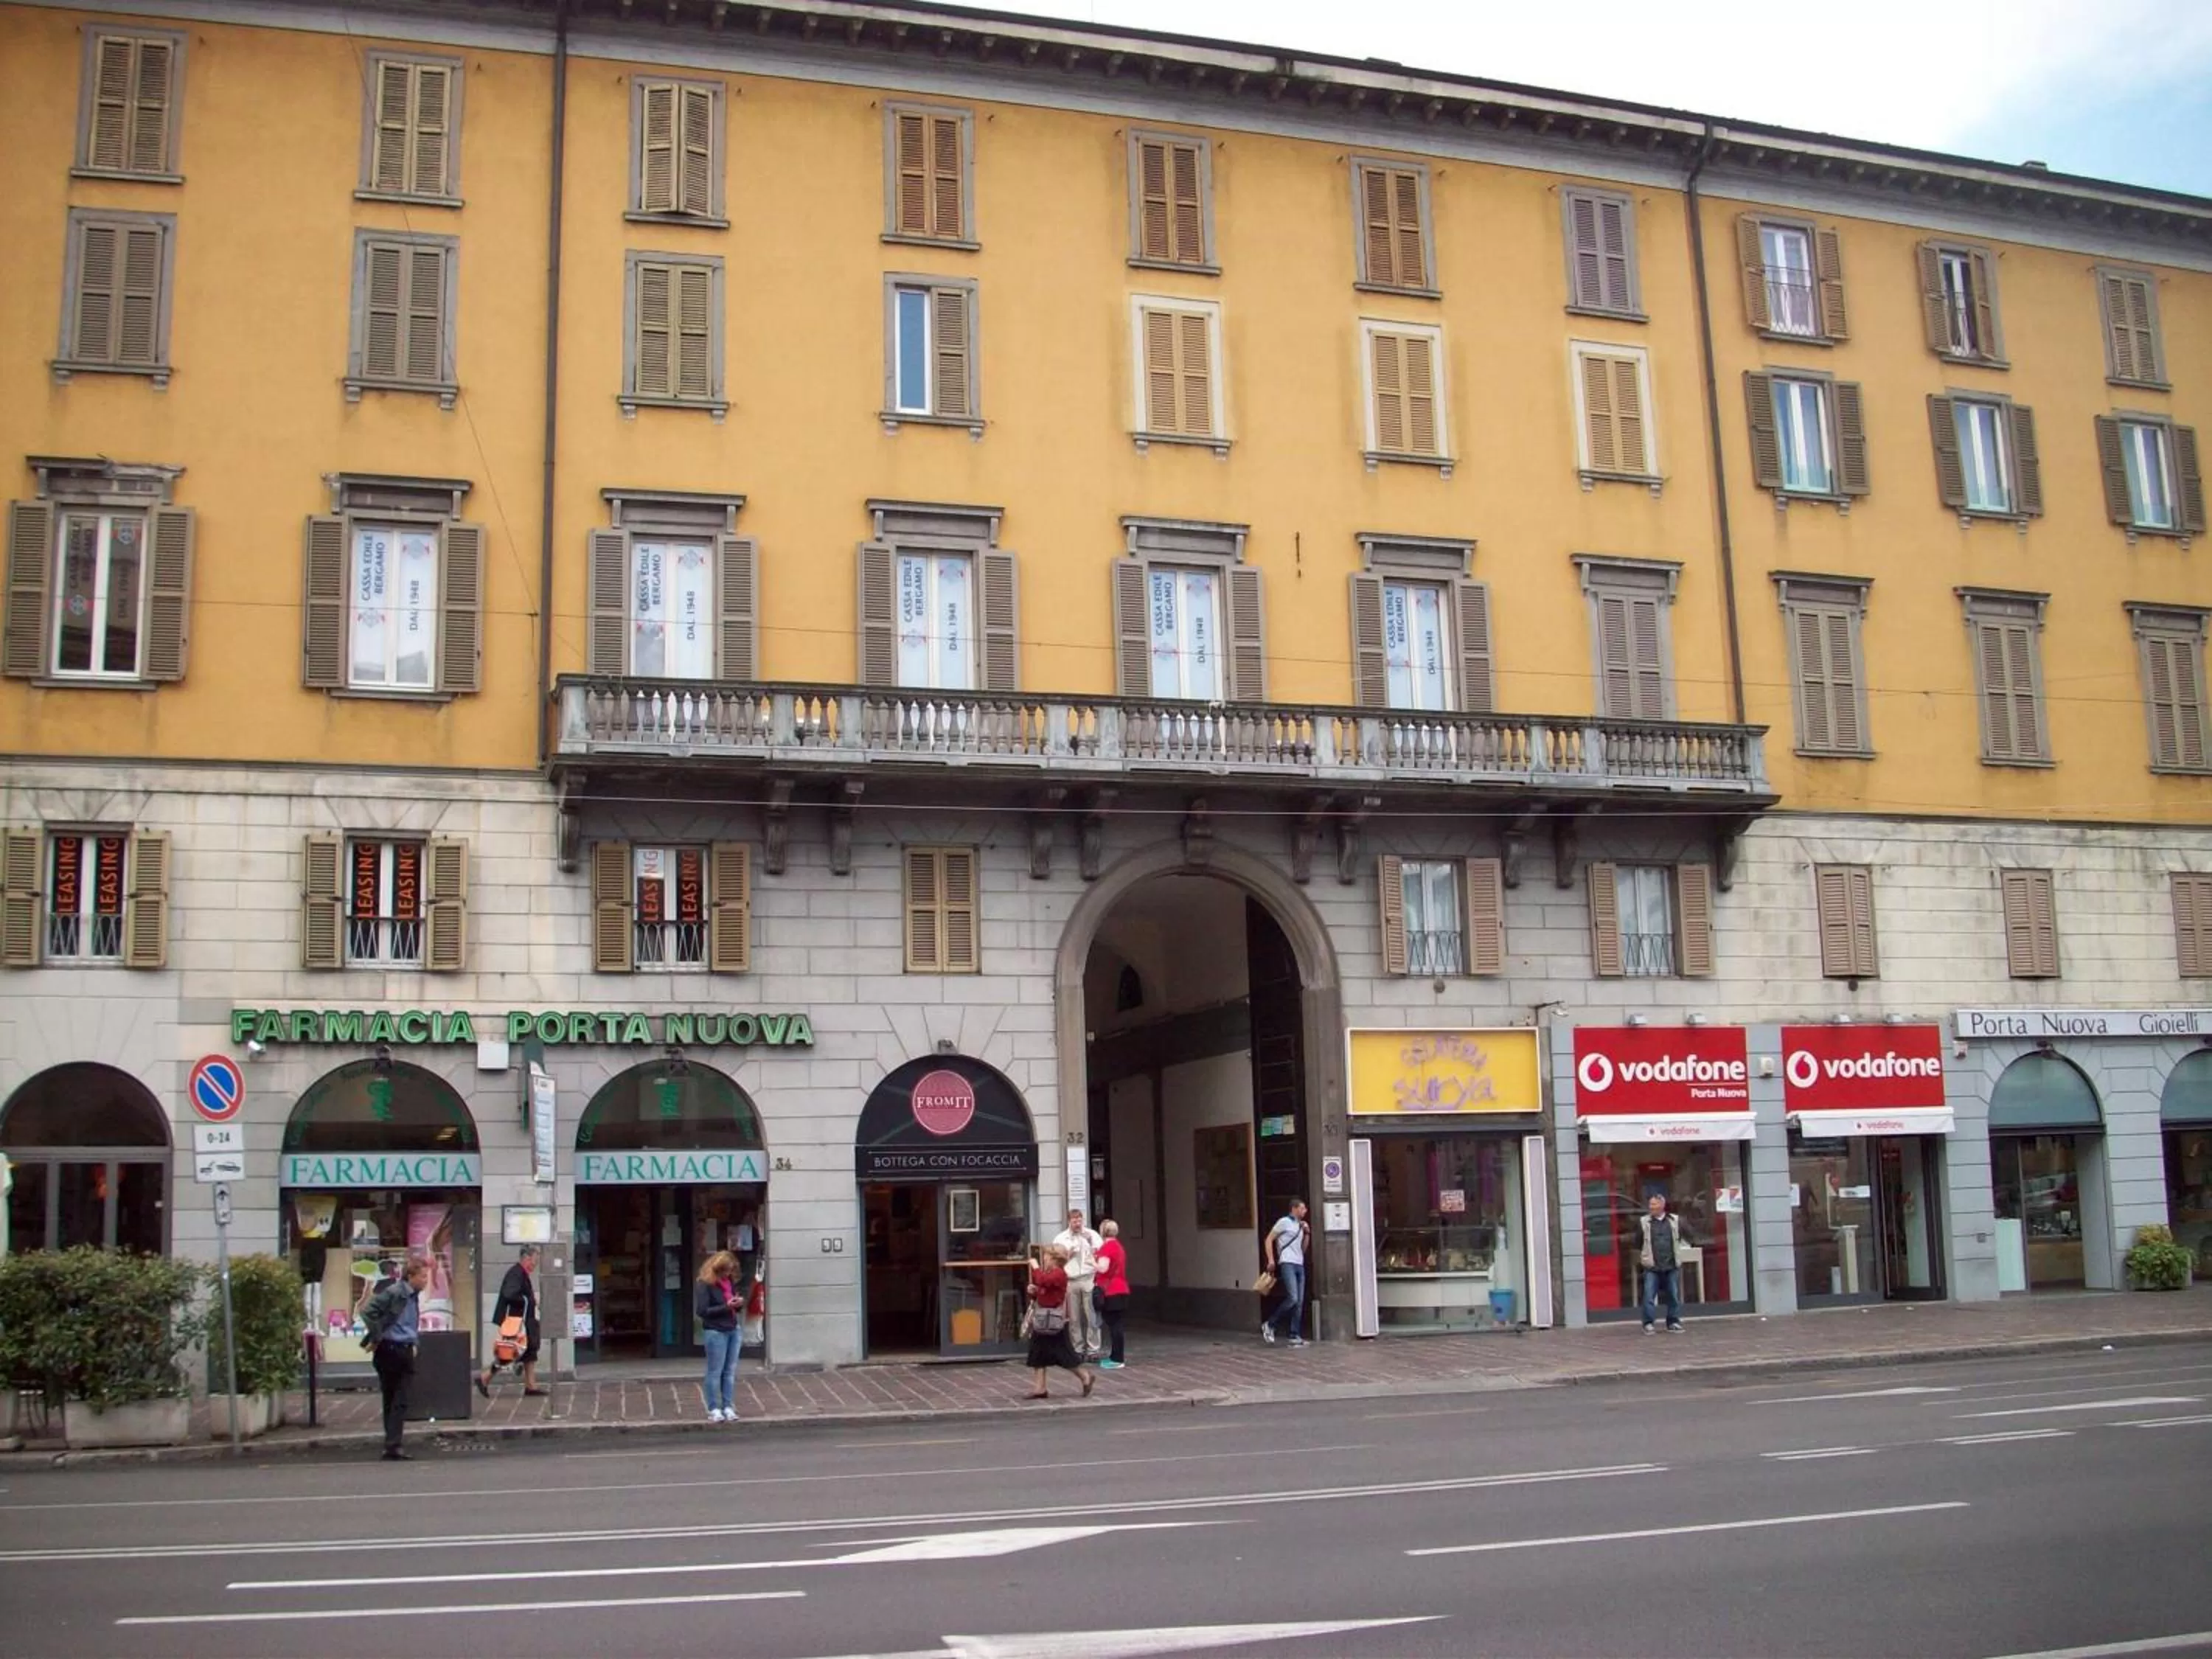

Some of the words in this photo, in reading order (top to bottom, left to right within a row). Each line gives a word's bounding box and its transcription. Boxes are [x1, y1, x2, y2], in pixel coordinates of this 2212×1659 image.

[364, 535, 373, 564] EDILE
[641, 546, 650, 576] EDILE
[374, 542, 385, 594] BERGAMO
[652, 554, 661, 605] BERGAMO
[903, 557, 912, 588] EDILE
[361, 567, 372, 601] CASSA
[409, 580, 420, 605] 1948
[639, 579, 650, 611] CASSA
[914, 567, 923, 616] BERGAMO
[1153, 574, 1163, 602] EDILE
[686, 591, 695, 614] 1948
[904, 591, 913, 622] CASSA
[948, 603, 957, 626] 1948
[1164, 582, 1174, 630] BERGAMO
[409, 608, 419, 631] DAL
[686, 621, 695, 640] DAL
[1154, 606, 1164, 636] CASSA
[1388, 619, 1396, 648] CASSA
[1395, 597, 1405, 642] BERGAMO
[949, 631, 958, 651] DAL
[1197, 644, 1206, 664] DAL
[58, 838, 77, 912] LEASING
[100, 838, 119, 913] LEASING
[357, 844, 375, 919] LEASING
[398, 844, 414, 919] LEASING
[681, 850, 697, 922] LEASING
[232, 1009, 477, 1043] FARMACIA
[507, 1011, 655, 1044] PORTA
[664, 1013, 815, 1046] NUOVA
[1971, 1012, 2028, 1035] Porta
[2041, 1014, 2107, 1034] Nuova
[2139, 1012, 2199, 1034] Gioielli
[1618, 1054, 1746, 1082] vodafone
[1823, 1051, 1940, 1078] vodafone
[917, 1096, 971, 1108] FROMIT
[1691, 1088, 1716, 1098] Porta
[1717, 1088, 1747, 1098] Nuova
[1067, 1132, 1084, 1144] 32
[1660, 1126, 1700, 1135] vodafone
[291, 1157, 473, 1183] FARMACIA
[583, 1155, 759, 1180] FARMACIA
[874, 1156, 925, 1167] BOTTEGA
[930, 1155, 958, 1166] CON
[961, 1155, 1020, 1165] FOCACCIA
